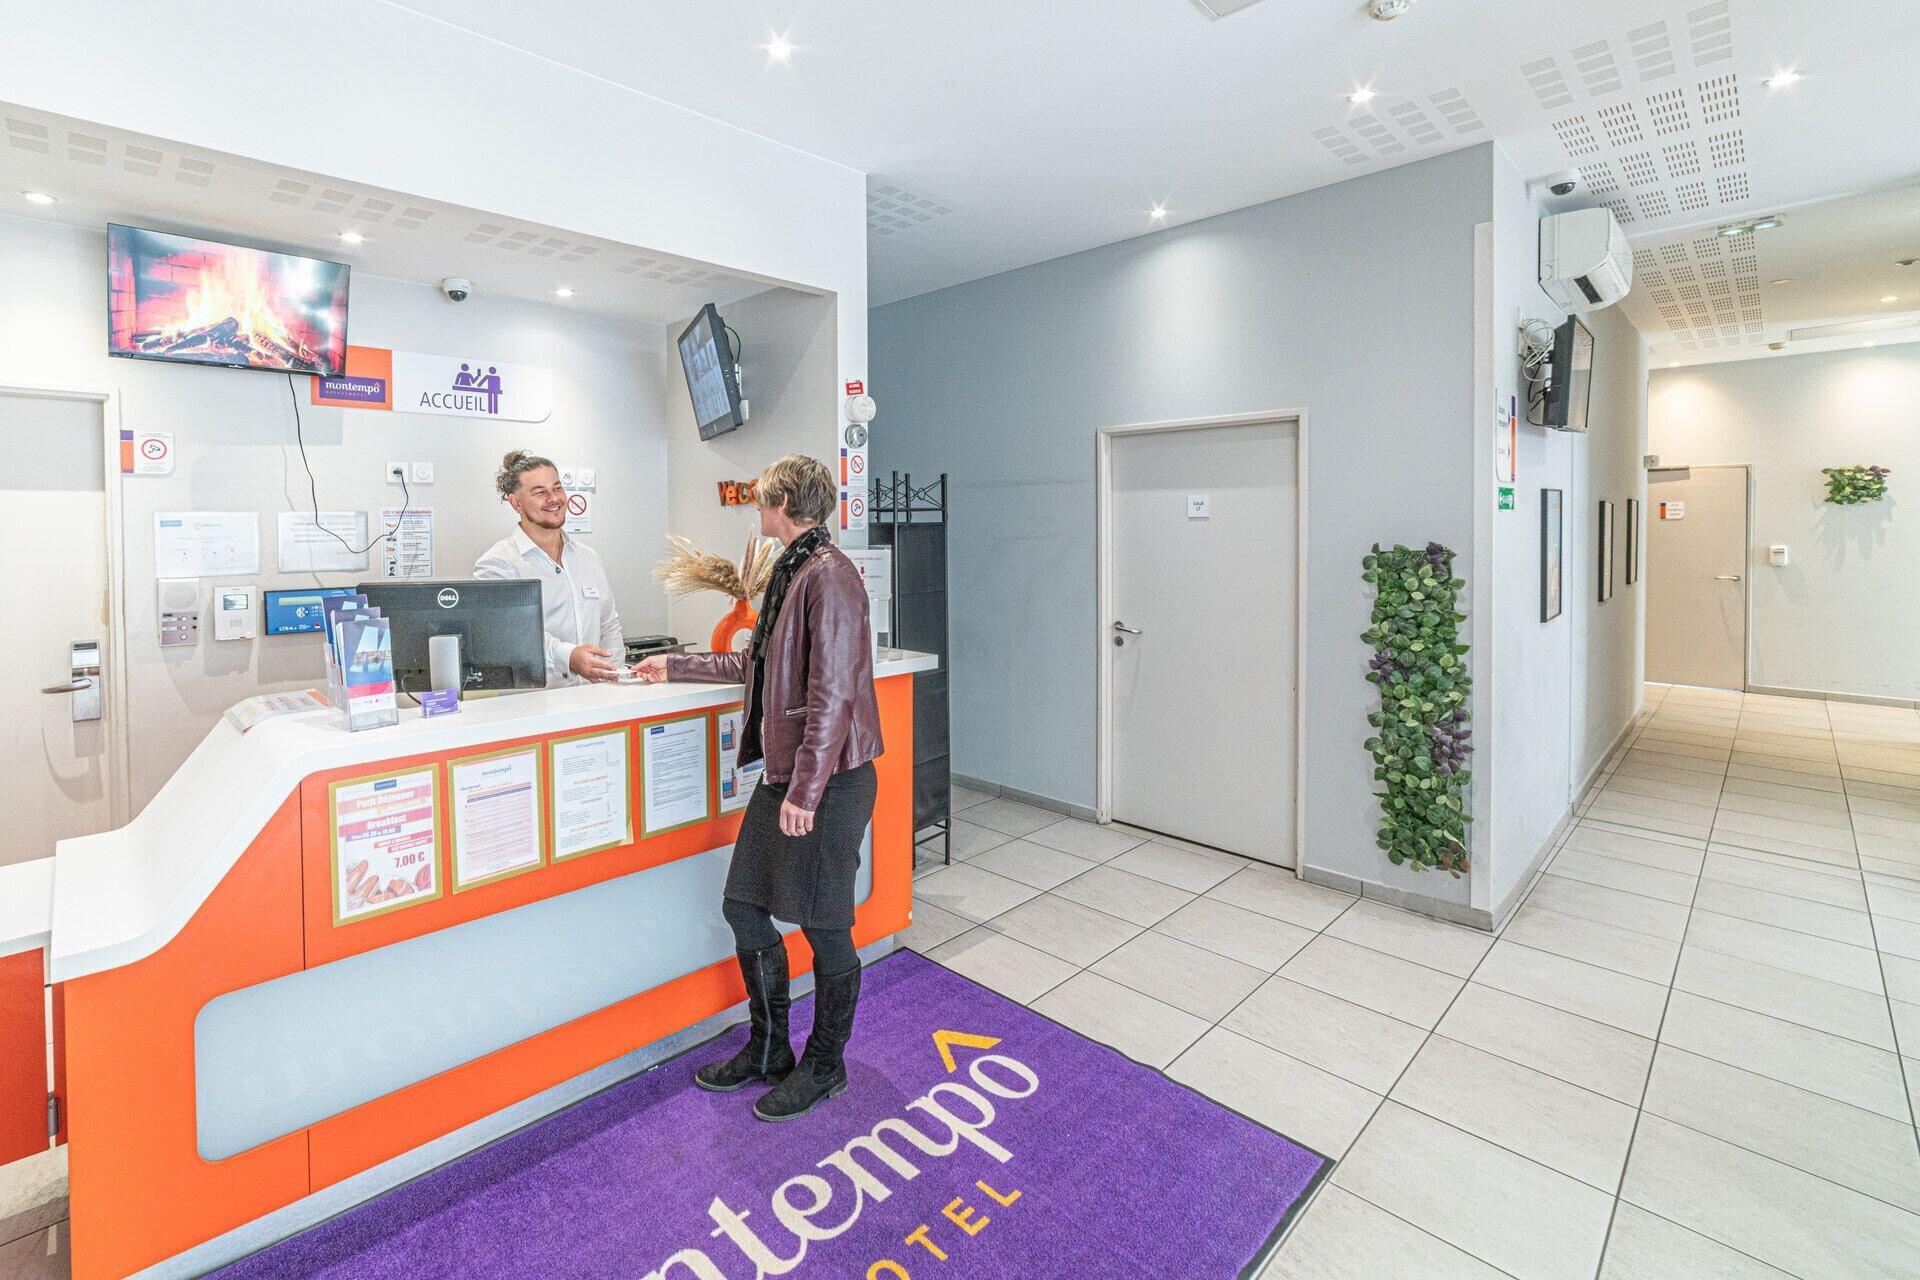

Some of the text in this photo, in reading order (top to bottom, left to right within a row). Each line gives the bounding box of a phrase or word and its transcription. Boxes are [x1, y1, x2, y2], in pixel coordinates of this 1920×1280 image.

[325, 381, 381, 395] montempô
[419, 391, 487, 412] ACCUEIL
[356, 796, 377, 809] Petit
[377, 789, 415, 805] Déjeuner
[366, 814, 408, 829] Breakfast
[394, 851, 425, 868] 7,00 €
